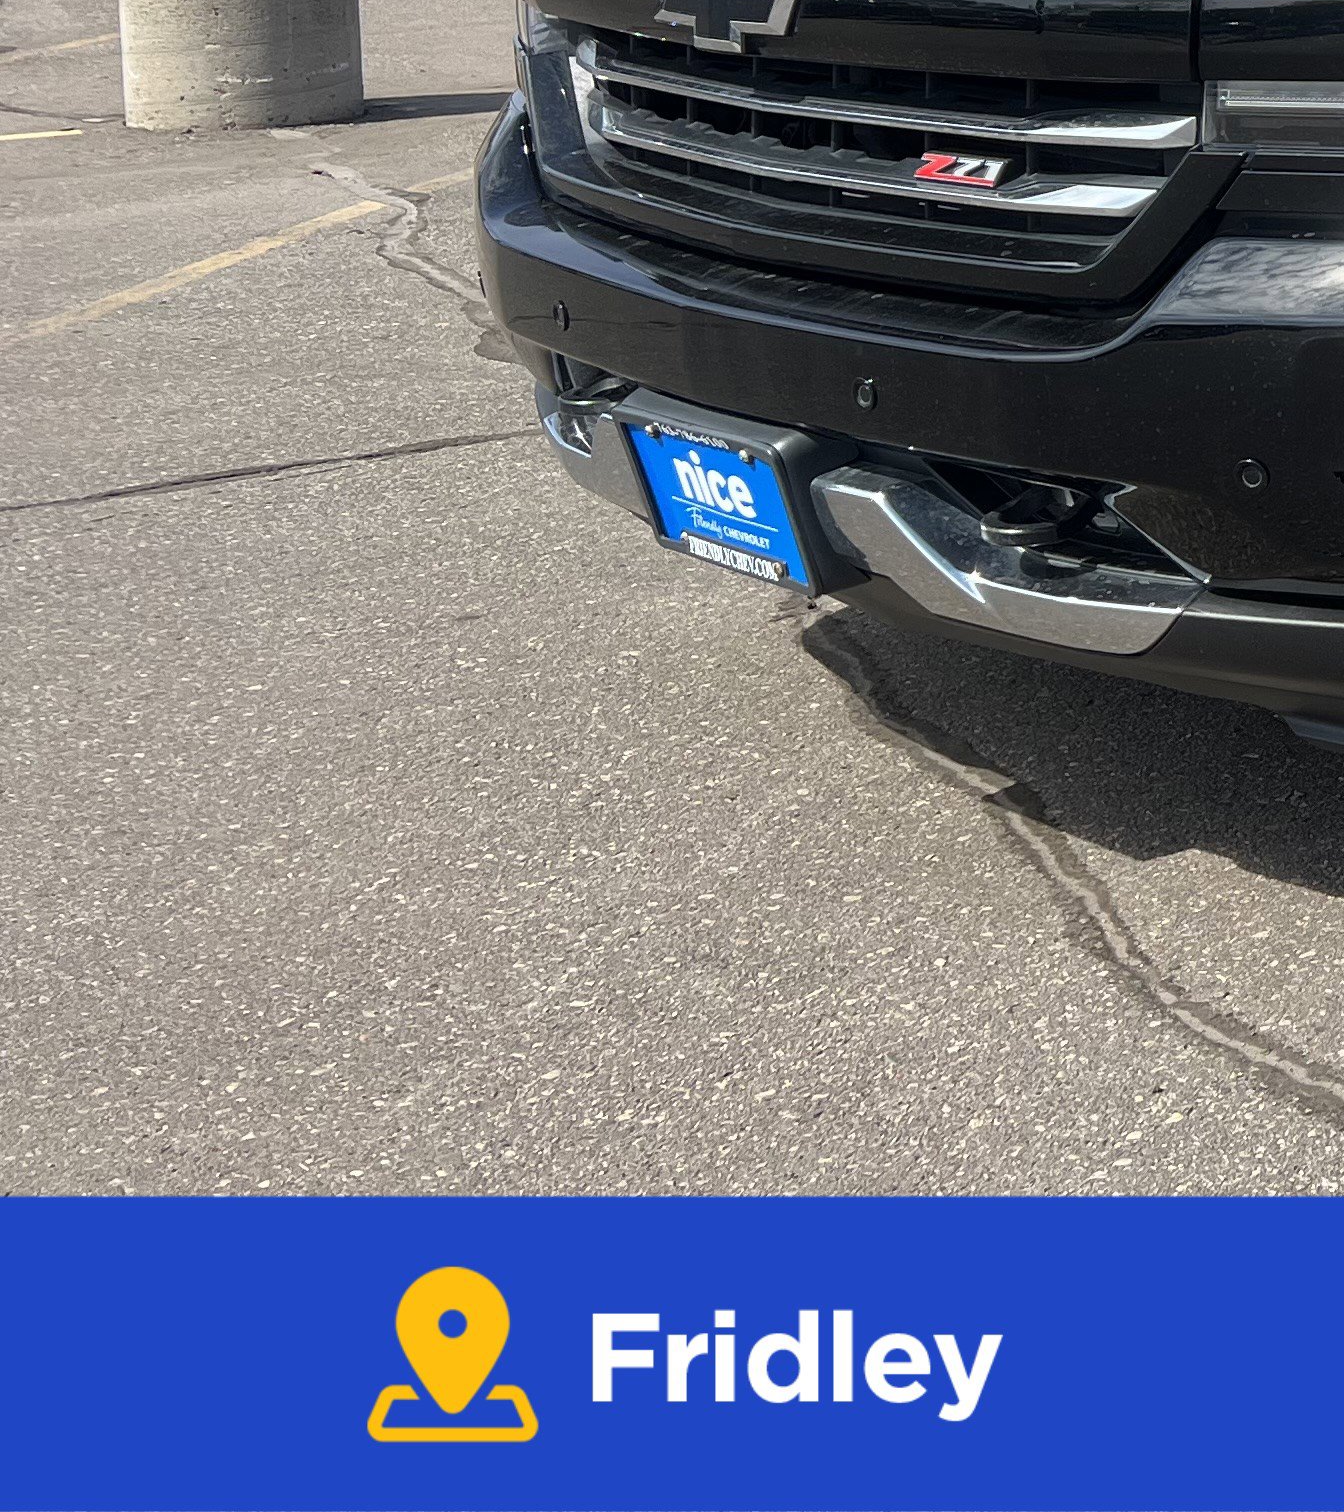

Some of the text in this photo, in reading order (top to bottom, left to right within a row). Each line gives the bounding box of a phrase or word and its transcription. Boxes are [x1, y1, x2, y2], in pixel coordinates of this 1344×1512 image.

[914, 152, 1005, 187] Z71
[672, 449, 758, 519] nice
[685, 506, 770, 550] Friendly CHEVROLET
